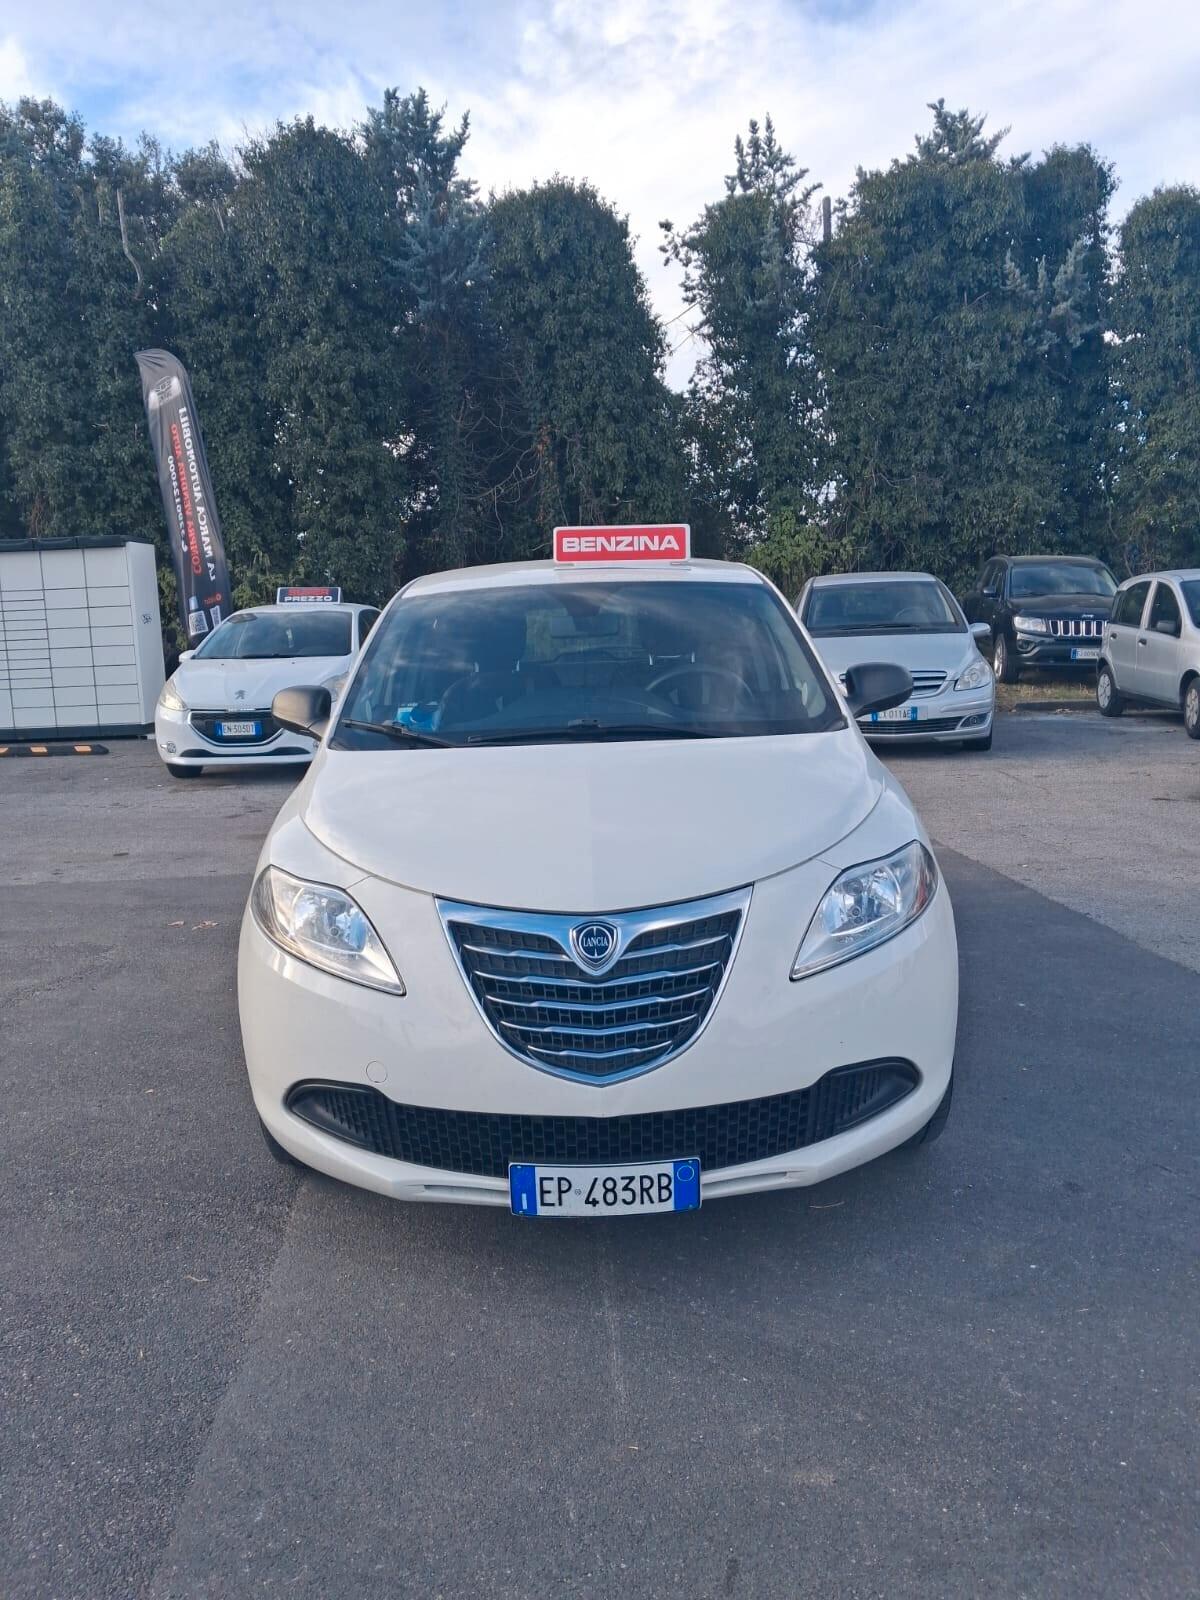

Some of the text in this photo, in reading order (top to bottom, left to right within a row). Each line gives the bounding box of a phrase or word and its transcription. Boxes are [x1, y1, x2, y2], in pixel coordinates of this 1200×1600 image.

[562, 535, 680, 553] BENZINA
[583, 936, 608, 947] LANCIA
[539, 1176, 572, 1207] EP
[584, 1173, 673, 1208] 483RB
